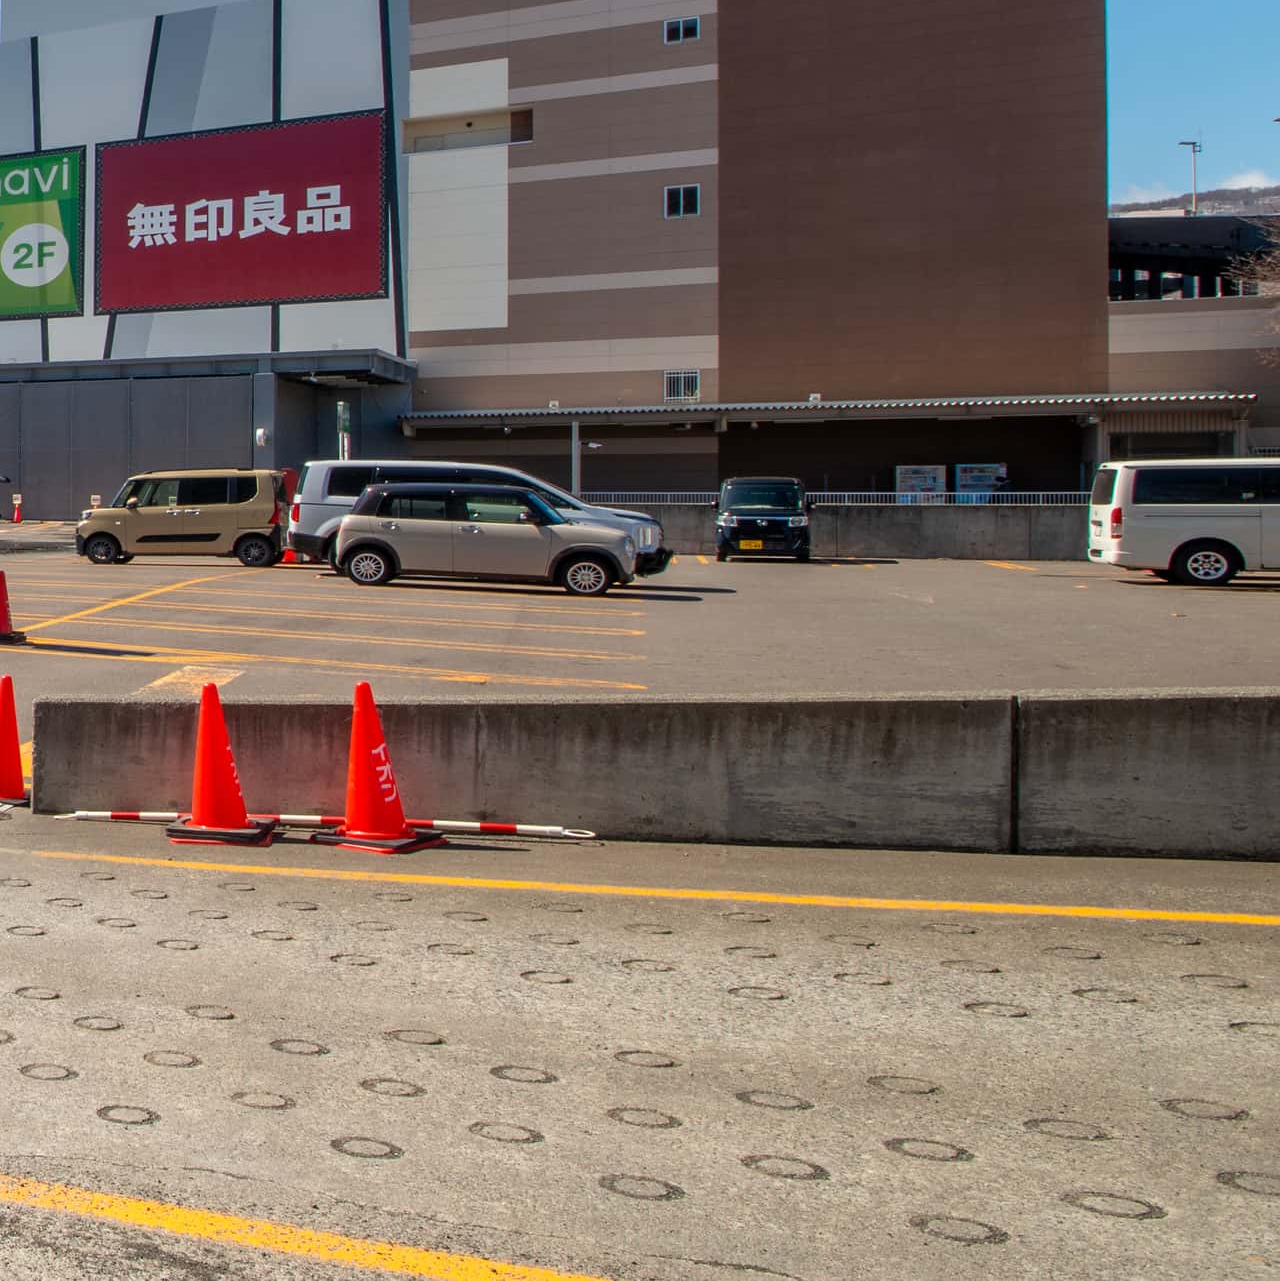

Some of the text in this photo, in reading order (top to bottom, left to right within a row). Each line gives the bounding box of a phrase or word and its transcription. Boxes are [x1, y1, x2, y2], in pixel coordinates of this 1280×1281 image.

[127, 184, 351, 249] 無印良品
[12, 241, 57, 270] 2F
